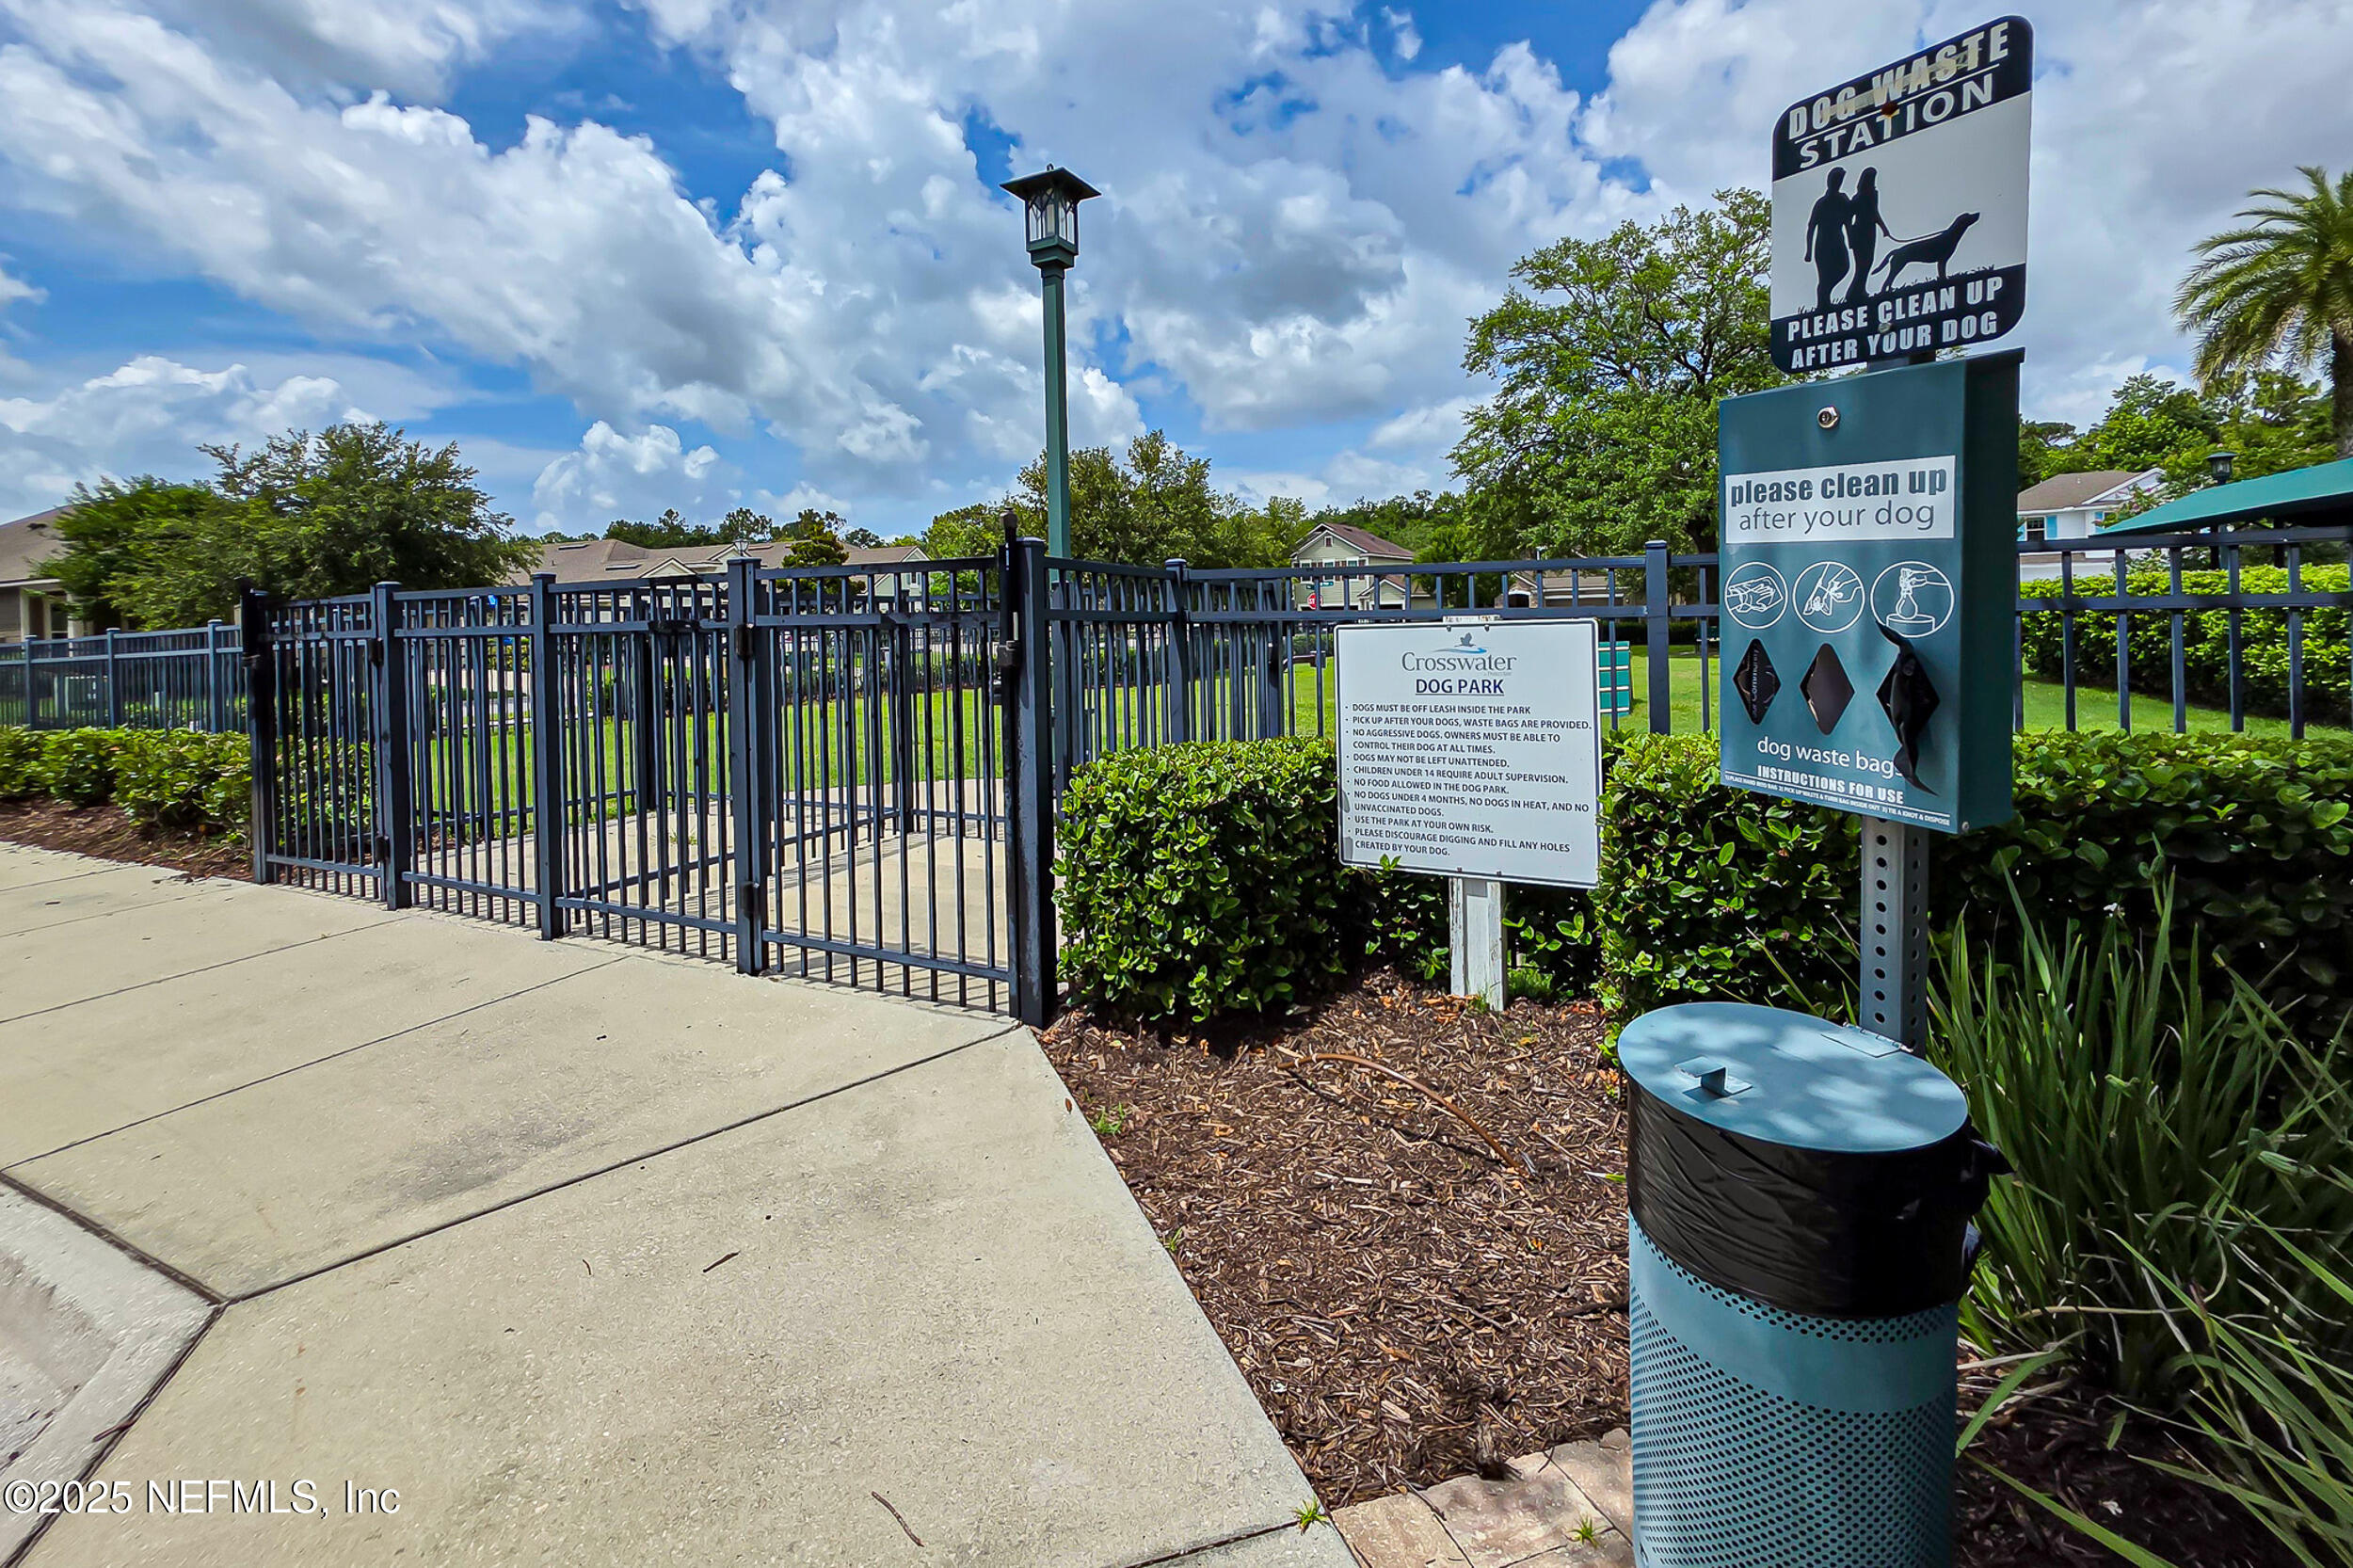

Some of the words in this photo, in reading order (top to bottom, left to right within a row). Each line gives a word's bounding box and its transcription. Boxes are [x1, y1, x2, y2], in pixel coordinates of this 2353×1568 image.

[1789, 87, 1856, 140] DOG
[1872, 22, 2009, 106] WASTE
[1800, 73, 1993, 168] STATION
[1788, 305, 1868, 342] PLEASE
[1878, 287, 1956, 324] CLEAN
[1967, 277, 2003, 304] UP
[1791, 340, 1858, 369] AFTER
[1867, 324, 1930, 356] YOUR
[1942, 312, 1997, 341] DOG
[1731, 480, 1813, 507] please
[1821, 472, 1898, 499] clean
[1909, 469, 1947, 495] up
[1739, 507, 1797, 531] after
[1804, 508, 1866, 535] your
[1875, 500, 1934, 531] dog
[1402, 651, 1517, 672] Crosswater
[1416, 679, 1452, 693] DOG
[1459, 679, 1504, 694] PARK
[1401, 704, 1410, 712] BE
[1458, 705, 1485, 713] INSIDE
[1507, 706, 1530, 714] PARK
[1435, 718, 1462, 727] DOGS,
[1541, 720, 1592, 729] PROVIDED.
[1353, 741, 1389, 749] CONTROL
[1366, 729, 1415, 738] AGGRESSIVE
[1417, 730, 1442, 739] DOGS.
[1444, 731, 1483, 740] OWNERS
[1483, 732, 1508, 741] MUST
[1523, 733, 1545, 742] ABLE
[1548, 734, 1561, 743] TO
[1757, 736, 1790, 760] dog
[1796, 745, 1850, 767] waste
[1449, 758, 1510, 767] UNATTENDED.
[1353, 766, 1392, 775] CHILDREN
[1394, 768, 1422, 776] UNDER
[1436, 770, 1472, 779] REQUIRE
[1474, 772, 1503, 780] ADULT
[1505, 773, 1568, 784] SUPERVISION.
[1757, 765, 1845, 792] INSTRUCTIONS
[1849, 781, 1873, 798] FOR
[1878, 788, 1904, 804] USE
[1392, 780, 1431, 790] ALLOWED
[1483, 785, 1509, 793] PARK.
[1354, 804, 1417, 813] UNVACCINATED
[1418, 807, 1444, 816] DOGS.
[1369, 792, 1389, 800] DOGS
[1392, 793, 1419, 802] UNDER
[1429, 795, 1467, 805] MONTHS,
[1469, 797, 1482, 806] NO
[1523, 801, 1549, 810] HEAT,
[1552, 802, 1572, 811] AND
[1575, 804, 1589, 812] NO
[1388, 818, 1410, 826] PARK
[1423, 821, 1447, 829] YOUR
[1449, 823, 1469, 831] OWN
[1472, 824, 1494, 833] RISK.
[1355, 828, 1384, 838] PLEASE
[1385, 830, 1437, 841] DISCOURAGE
[1439, 834, 1476, 844] DIGGING
[1478, 838, 1497, 846] AND
[1499, 840, 1516, 848] FILL
[1519, 840, 1538, 849] ANY
[1540, 843, 1570, 852] HOLES
[1355, 840, 1390, 850] CREATED
[1404, 844, 1427, 853] YOUR
[1430, 847, 1449, 856] DOG.
